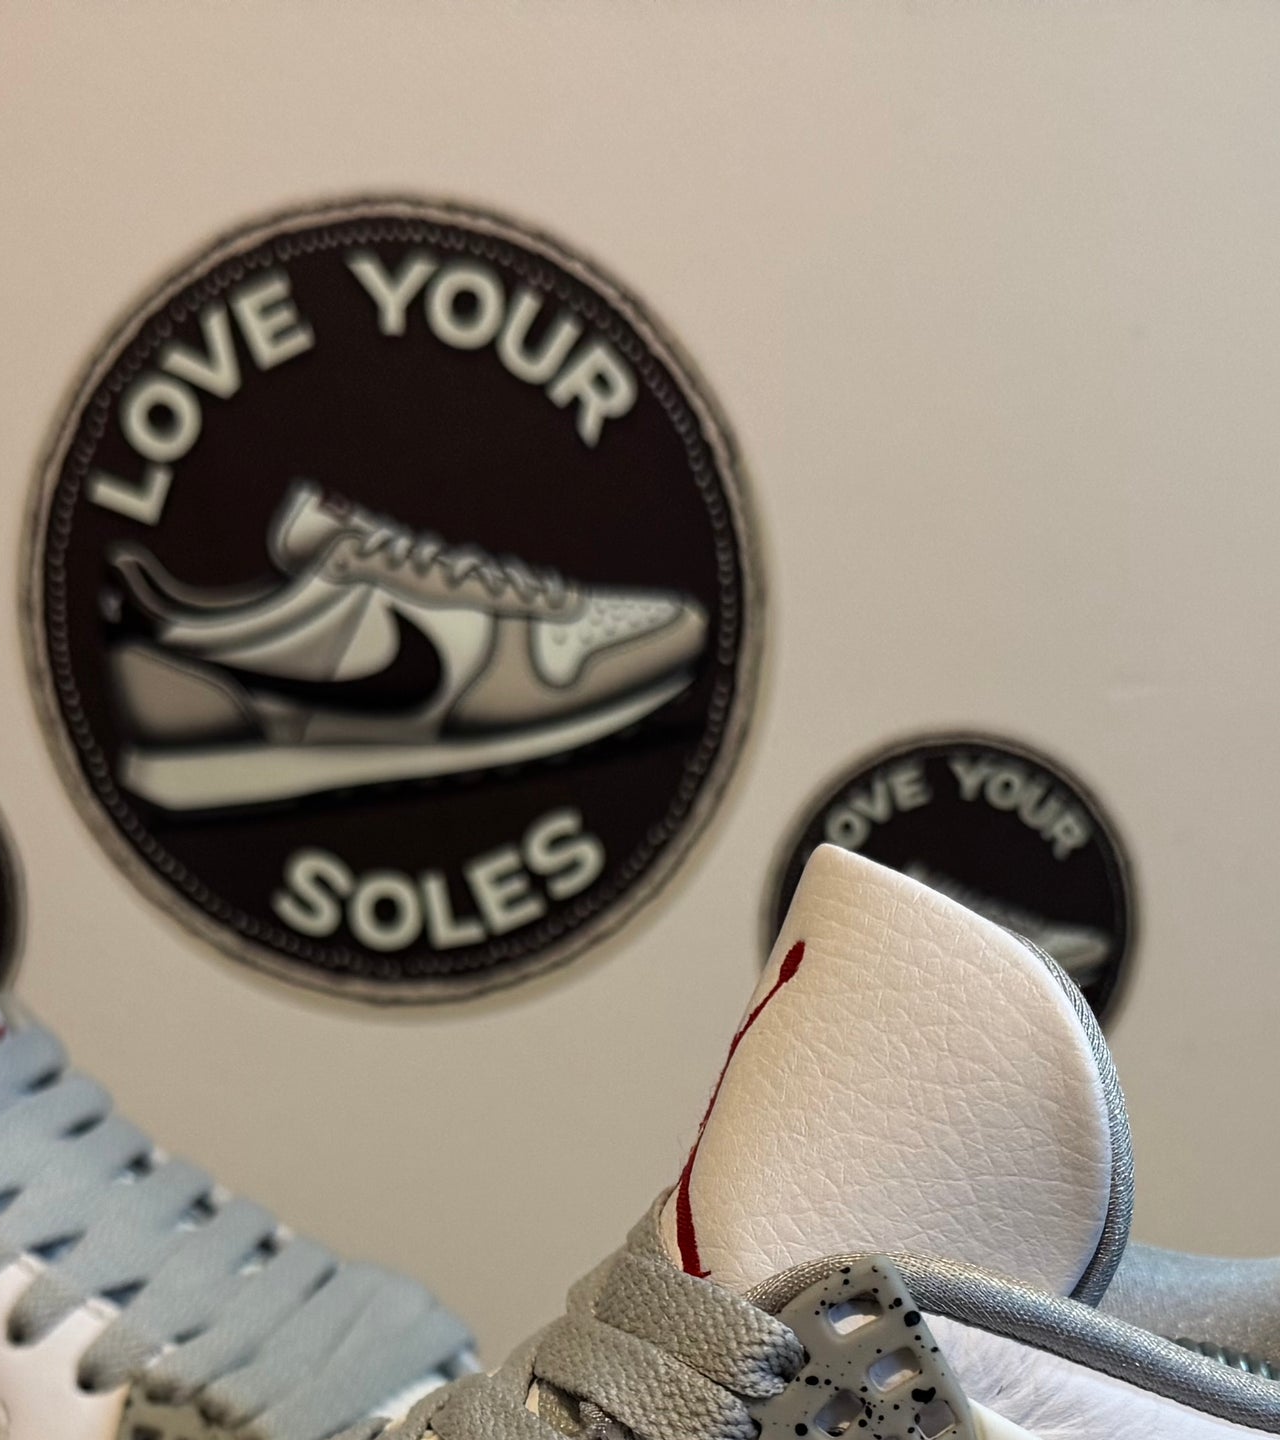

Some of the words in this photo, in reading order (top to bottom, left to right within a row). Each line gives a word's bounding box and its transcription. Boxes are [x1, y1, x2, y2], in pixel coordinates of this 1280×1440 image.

[88, 272, 316, 526] LOVE
[347, 254, 637, 448] YOUR
[273, 808, 605, 952] SOLES
[806, 768, 932, 858] OVE
[949, 757, 1090, 861] YOUR
